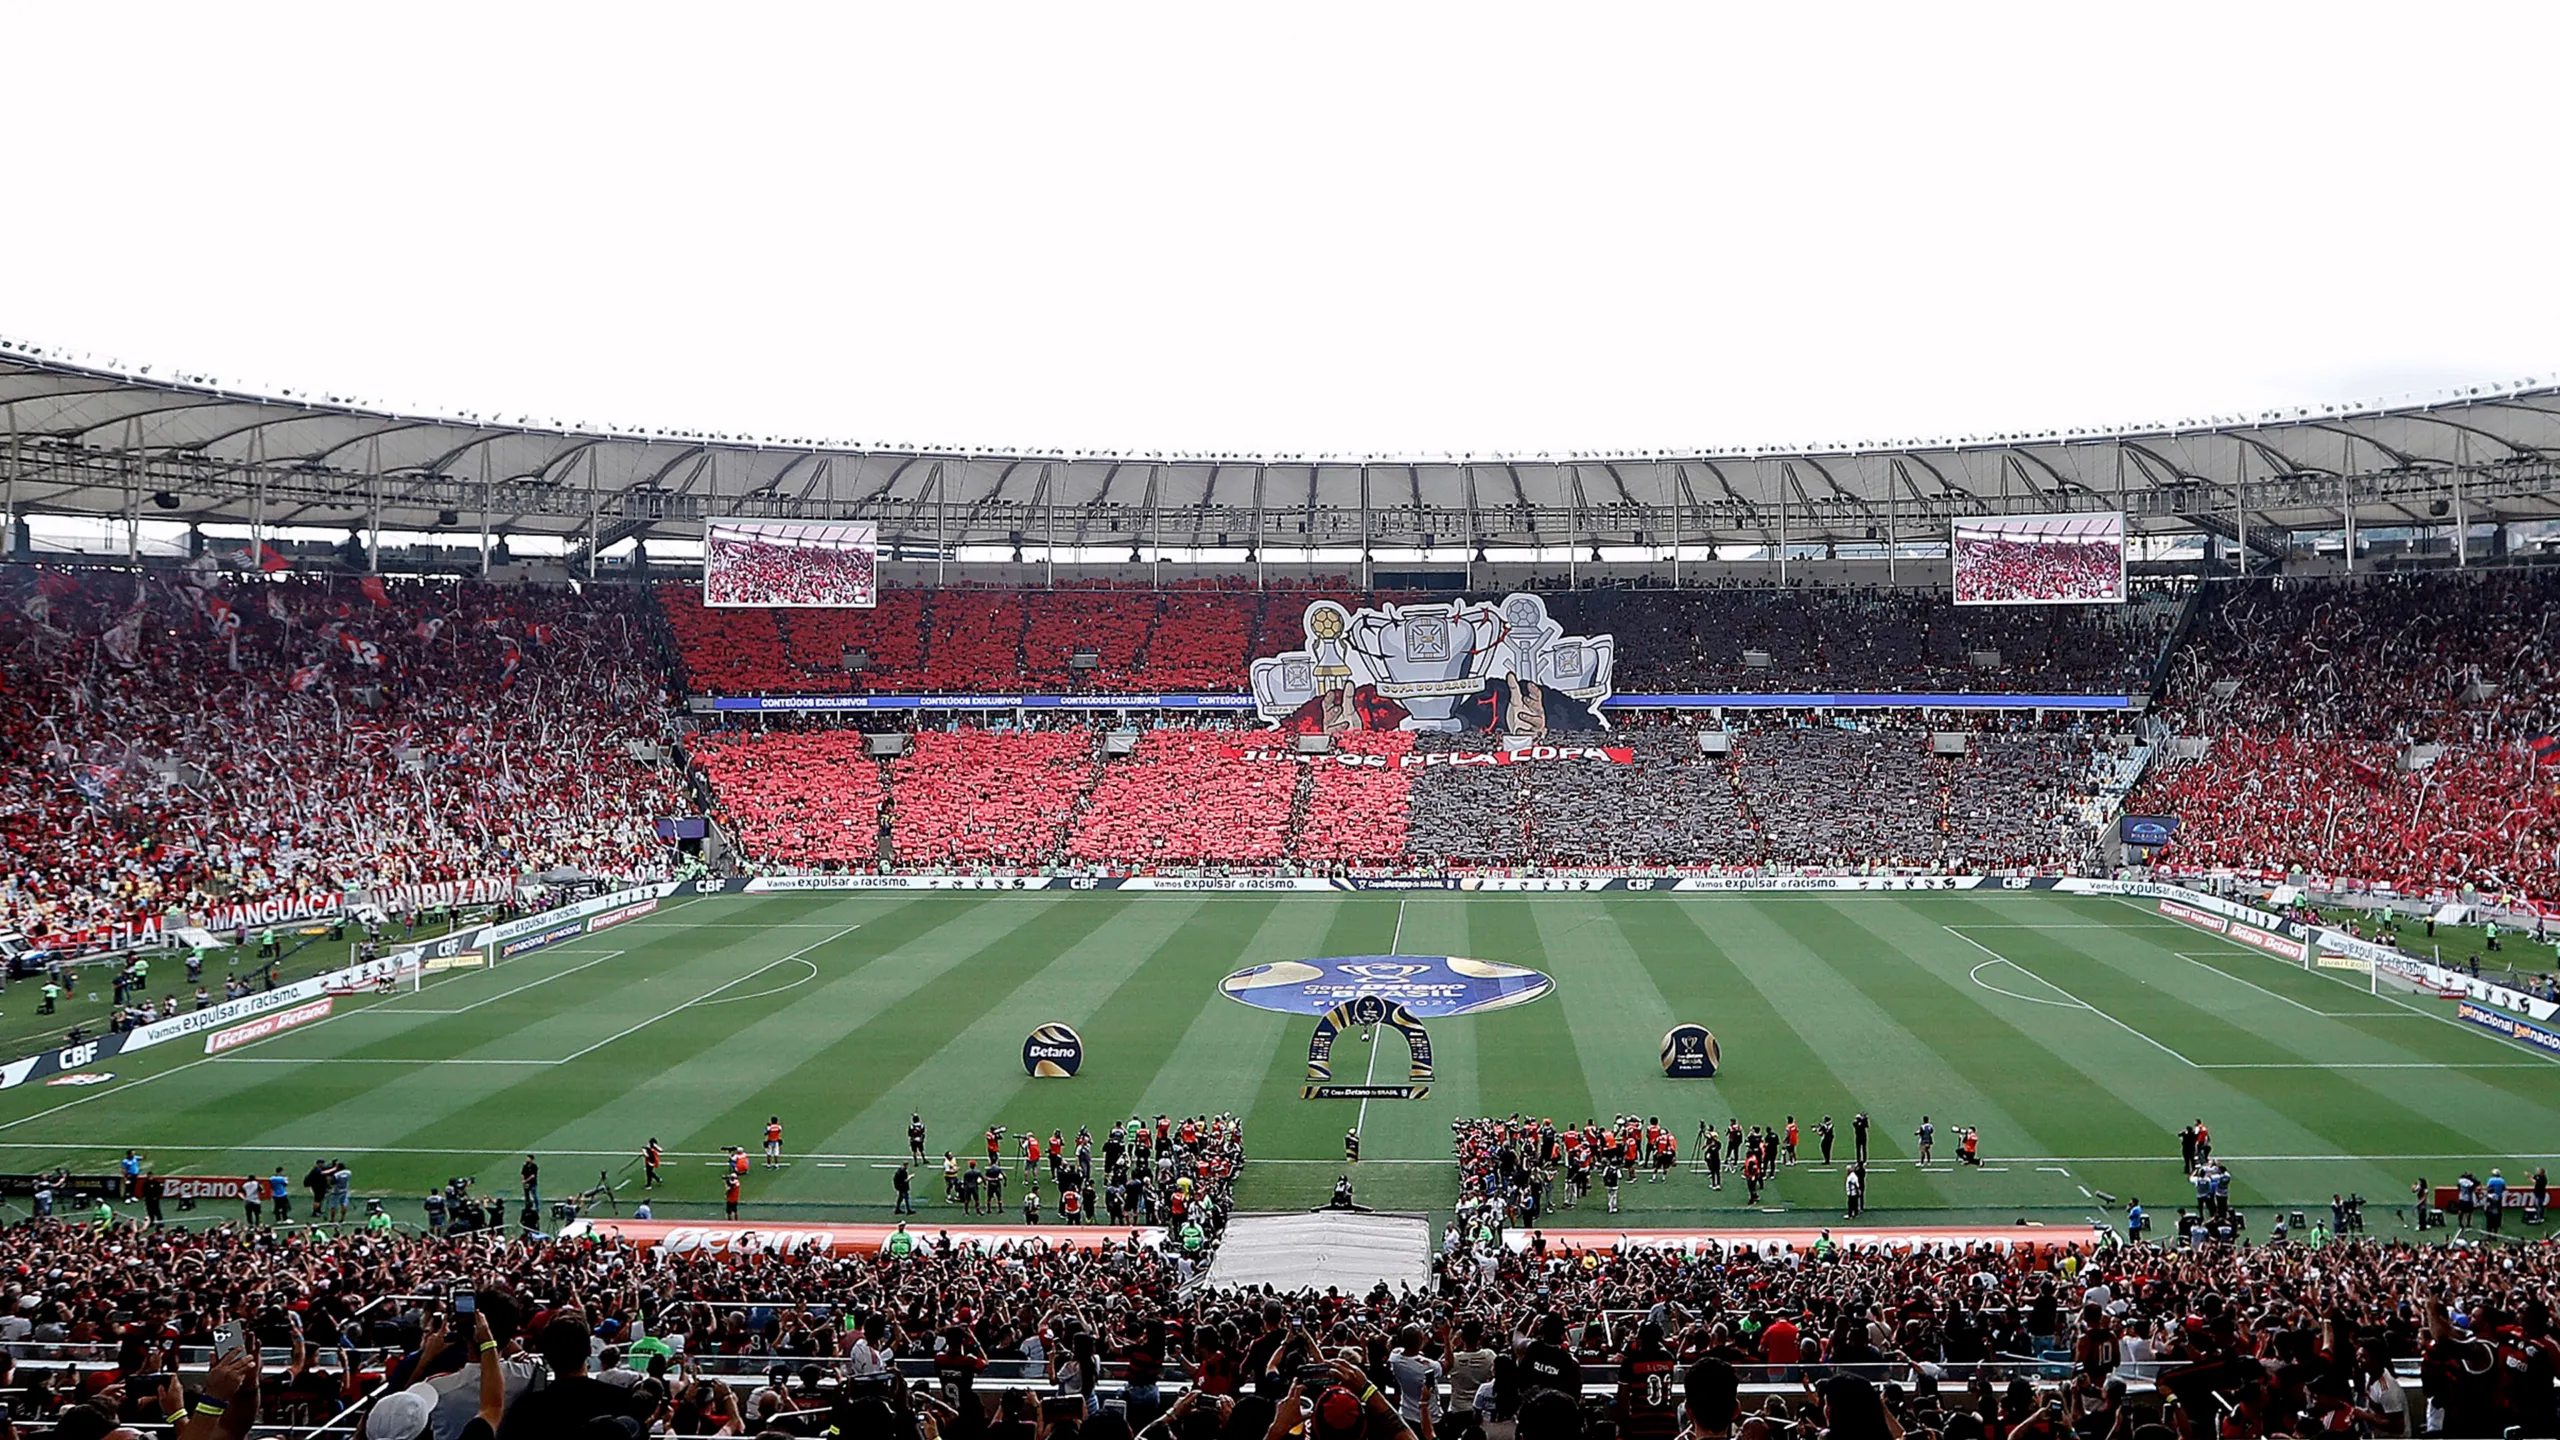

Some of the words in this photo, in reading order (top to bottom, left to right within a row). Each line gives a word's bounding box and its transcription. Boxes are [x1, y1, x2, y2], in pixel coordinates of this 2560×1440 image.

[761, 697, 815, 707] CONTEÚDOS
[816, 698, 868, 707] EXCLUSIVOS
[920, 696, 970, 706] CONTEÚDOS
[972, 696, 1022, 706] EXCLUSIVOS
[1060, 695, 1109, 706] CONTEÚDOS
[1110, 695, 1161, 706] EXCLUSIVOS
[1197, 695, 1247, 705] CONTEÚDOS
[1509, 745, 1612, 762] COPA
[695, 879, 725, 893] CBF
[767, 880, 797, 888] Vamos
[798, 876, 849, 890] expulsar
[860, 876, 910, 887] racismo.
[1069, 878, 1099, 890] CBF
[1154, 880, 1182, 888] Vamos
[1184, 877, 1235, 890] expulsar
[1247, 877, 1297, 888] racismo.
[1420, 880, 1444, 888] BRASIL
[1627, 879, 1655, 891] CBF
[1695, 880, 1723, 888] Vamos
[1725, 877, 1777, 891] expulsar
[1788, 877, 1839, 888] racismo.
[2002, 877, 2031, 889] CBF
[2089, 882, 2119, 891] Vamos
[2122, 882, 2171, 896] expulsar
[111, 918, 160, 950] FLA
[212, 895, 338, 930] MANGUAÇA
[2289, 922, 2307, 940] CBF
[438, 938, 459, 957] CBF
[2230, 926, 2263, 945] Betano
[2265, 937, 2300, 957] Betano
[1332, 990, 1463, 998] BRASIL
[1359, 983, 1467, 991] Betano
[147, 1024, 182, 1041] Vamos
[183, 1003, 240, 1031] expulsar
[250, 985, 302, 1012] racismo.
[2458, 1003, 2514, 1033] betnacional
[216, 1022, 273, 1049] Betano
[276, 1003, 329, 1029] Betano
[59, 1041, 99, 1069] CBF
[1029, 1045, 1076, 1058] Betano
[163, 1178, 239, 1198] Betano
[2098, 1342, 2112, 1366] 10
